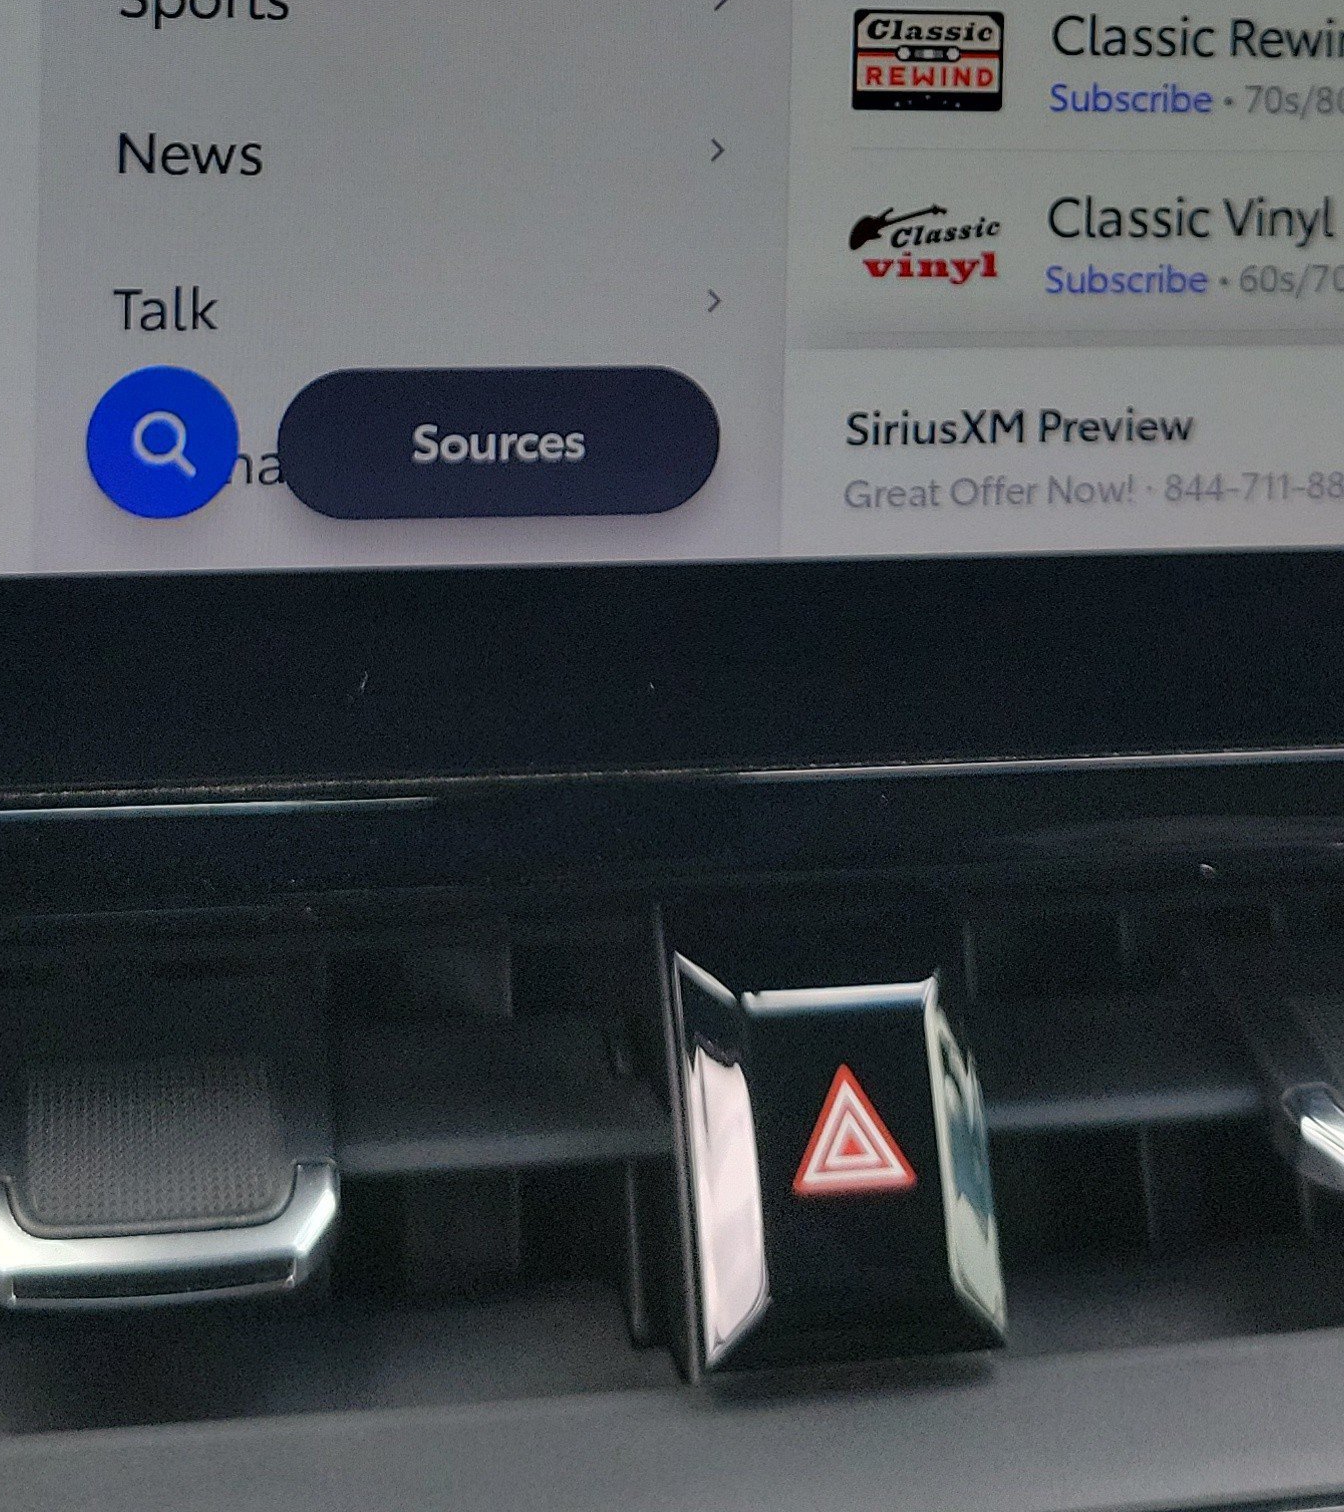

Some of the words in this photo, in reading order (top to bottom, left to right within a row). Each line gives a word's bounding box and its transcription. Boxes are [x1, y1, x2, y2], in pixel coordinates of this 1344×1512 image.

[866, 18, 994, 43] Classic
[1051, 13, 1216, 59] Classic
[865, 65, 994, 88] REWIND
[1049, 82, 1215, 115] Subscribe
[118, 132, 263, 177] News
[889, 216, 1002, 249] Classic
[1047, 195, 1211, 240] Classic
[1222, 195, 1335, 249] Vinyl
[862, 251, 998, 286] vinyl
[1045, 263, 1210, 296] Subscribe
[112, 285, 218, 333] Talk
[412, 423, 586, 464] Sources
[846, 409, 1025, 447] SiriusXM
[1038, 406, 1194, 444] Preview
[843, 479, 942, 510] Great
[949, 474, 1039, 508] Offer
[1047, 473, 1135, 506] Now!
